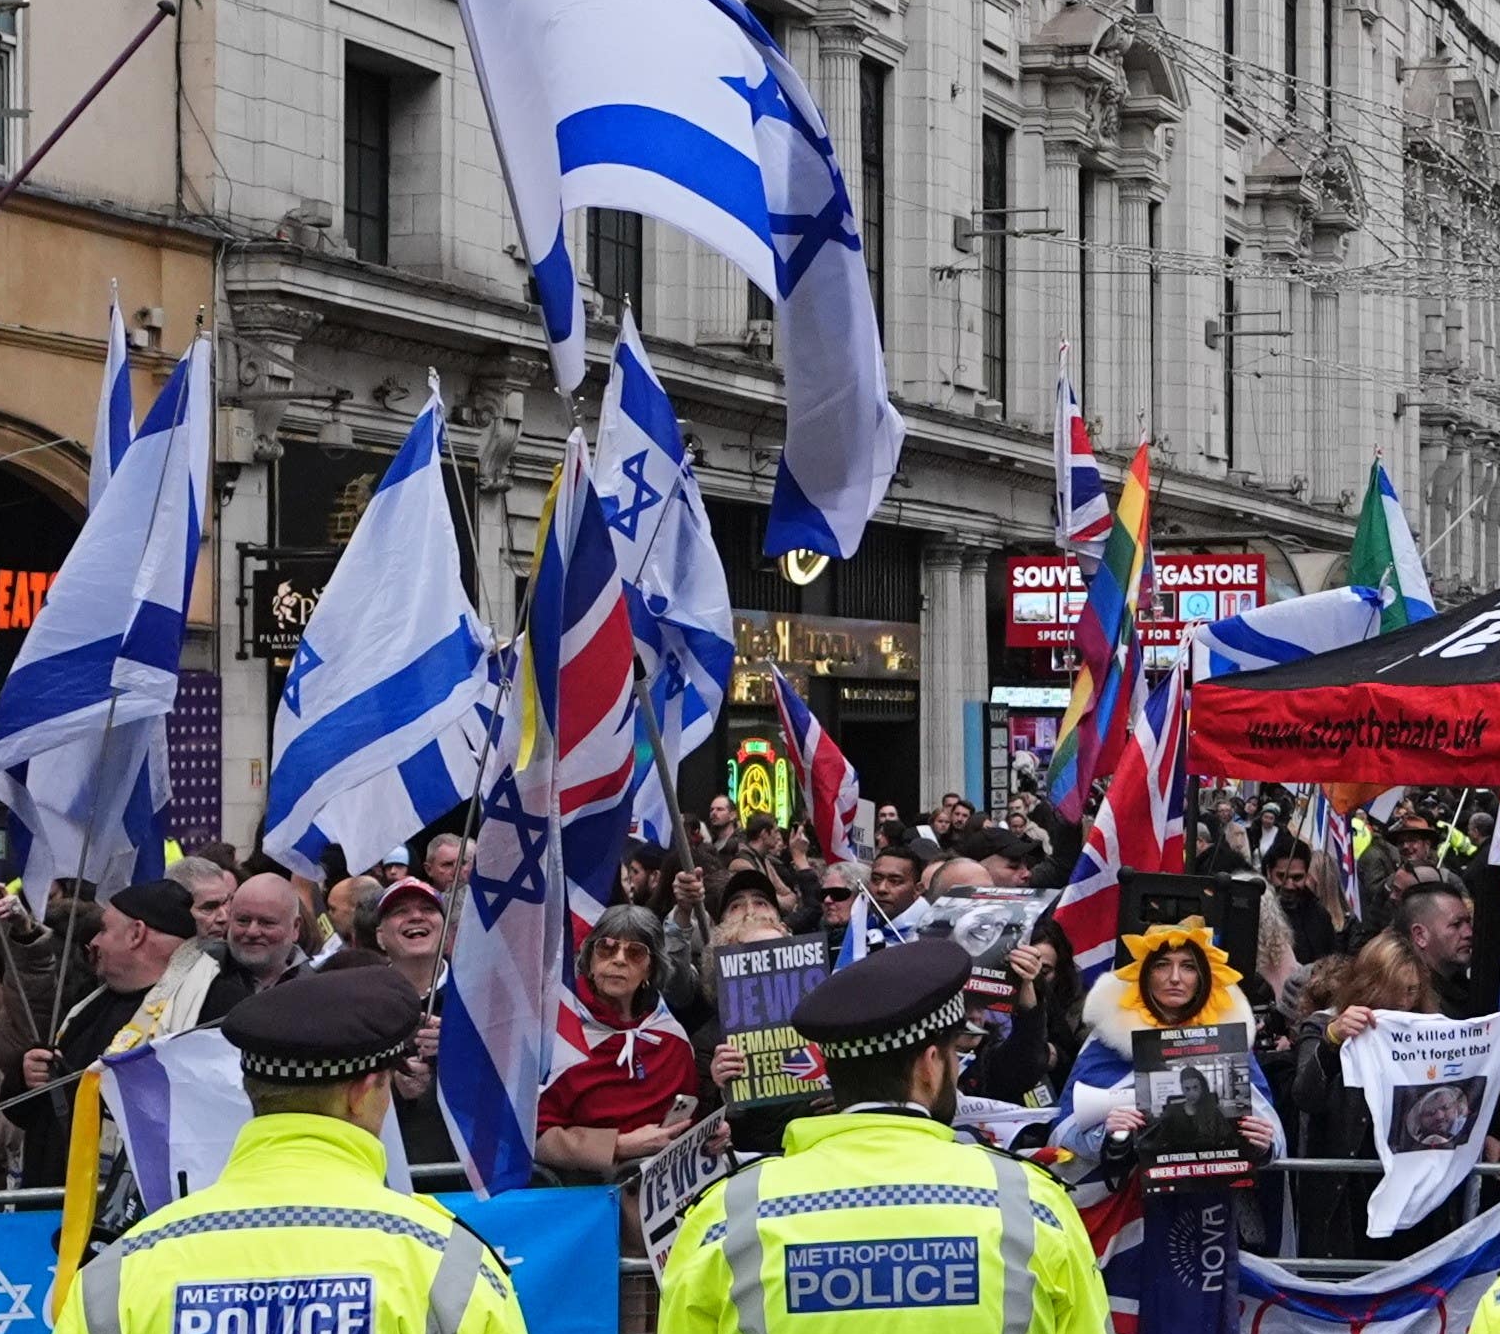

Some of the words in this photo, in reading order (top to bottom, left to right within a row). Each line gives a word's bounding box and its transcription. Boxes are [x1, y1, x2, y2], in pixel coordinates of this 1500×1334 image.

[719, 948, 772, 979] WE'RE
[772, 940, 825, 969] THOSE
[1391, 1032, 1412, 1043] We
[1417, 1029, 1455, 1042] killed
[1391, 1049, 1427, 1062] Don't
[1430, 1046, 1467, 1061] forget
[1469, 1043, 1491, 1056] that
[731, 1078, 749, 1103] IN
[645, 1133, 694, 1178] PROTECT
[696, 1116, 722, 1143] OUR
[1215, 1148, 1240, 1160] SILENCE
[1149, 1167, 1176, 1179] WHERE
[1176, 1165, 1192, 1177] ARE
[1192, 1164, 1206, 1175] THE
[1206, 1161, 1249, 1175] FEMINISTS?
[788, 1241, 976, 1267] METROPOLITAN
[181, 1281, 367, 1305] METROPOLITAN
[788, 1263, 976, 1309] POLICE
